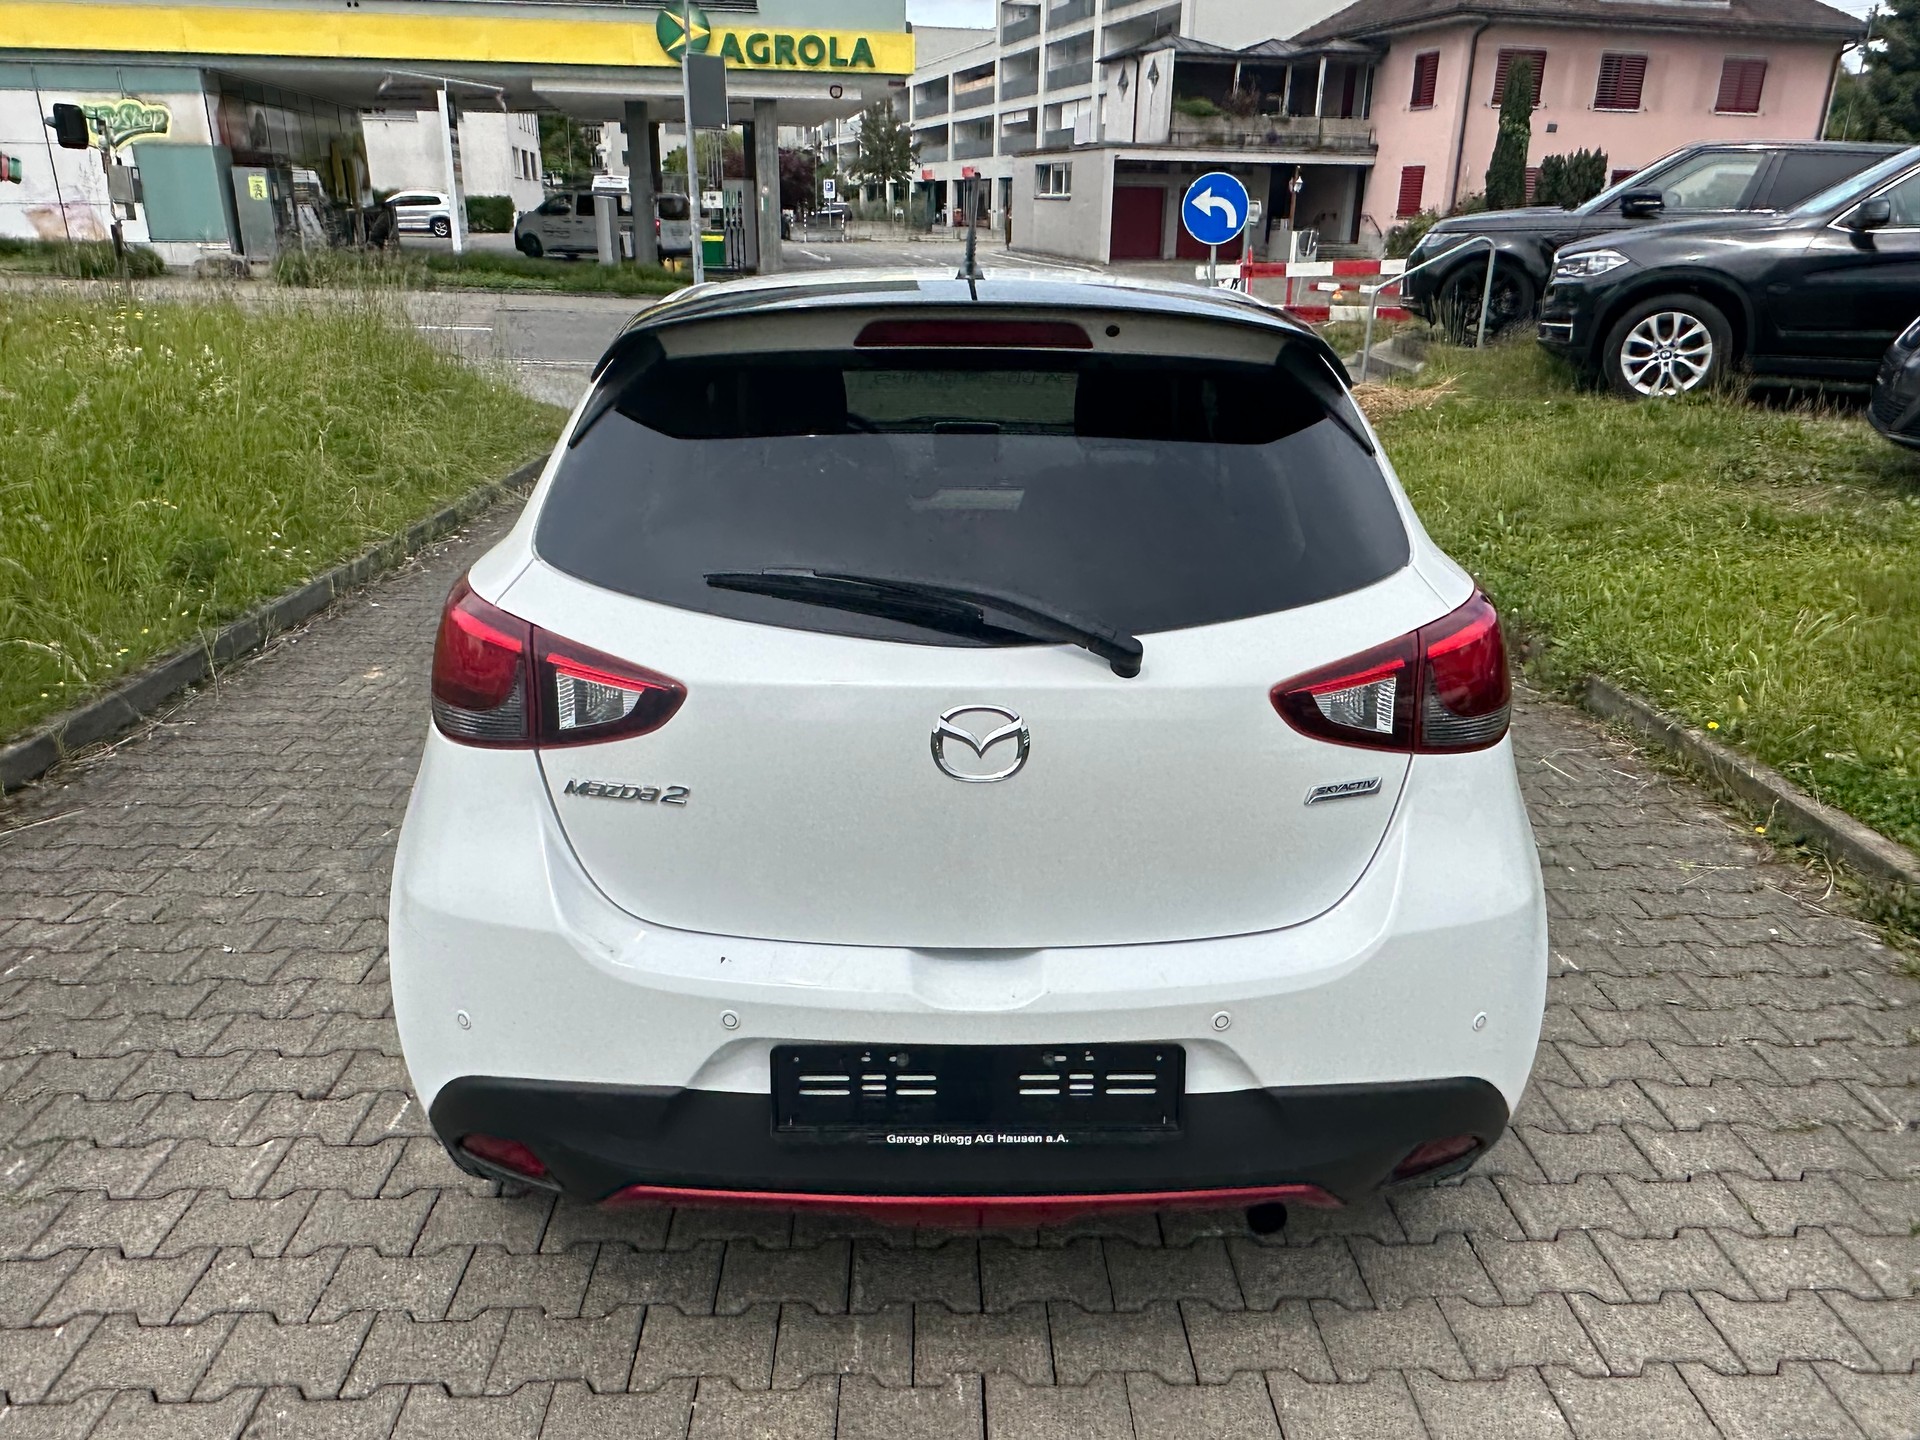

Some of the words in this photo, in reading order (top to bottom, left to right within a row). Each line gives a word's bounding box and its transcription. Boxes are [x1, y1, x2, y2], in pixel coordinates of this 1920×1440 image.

[720, 32, 876, 68] AGROLA
[1316, 779, 1377, 795] SKYACTIV
[886, 1133, 930, 1146] Garage
[933, 1133, 972, 1146] Rüegg
[974, 1133, 994, 1144] AG
[997, 1133, 1043, 1144] Hausen
[1045, 1133, 1070, 1144] a.A.
